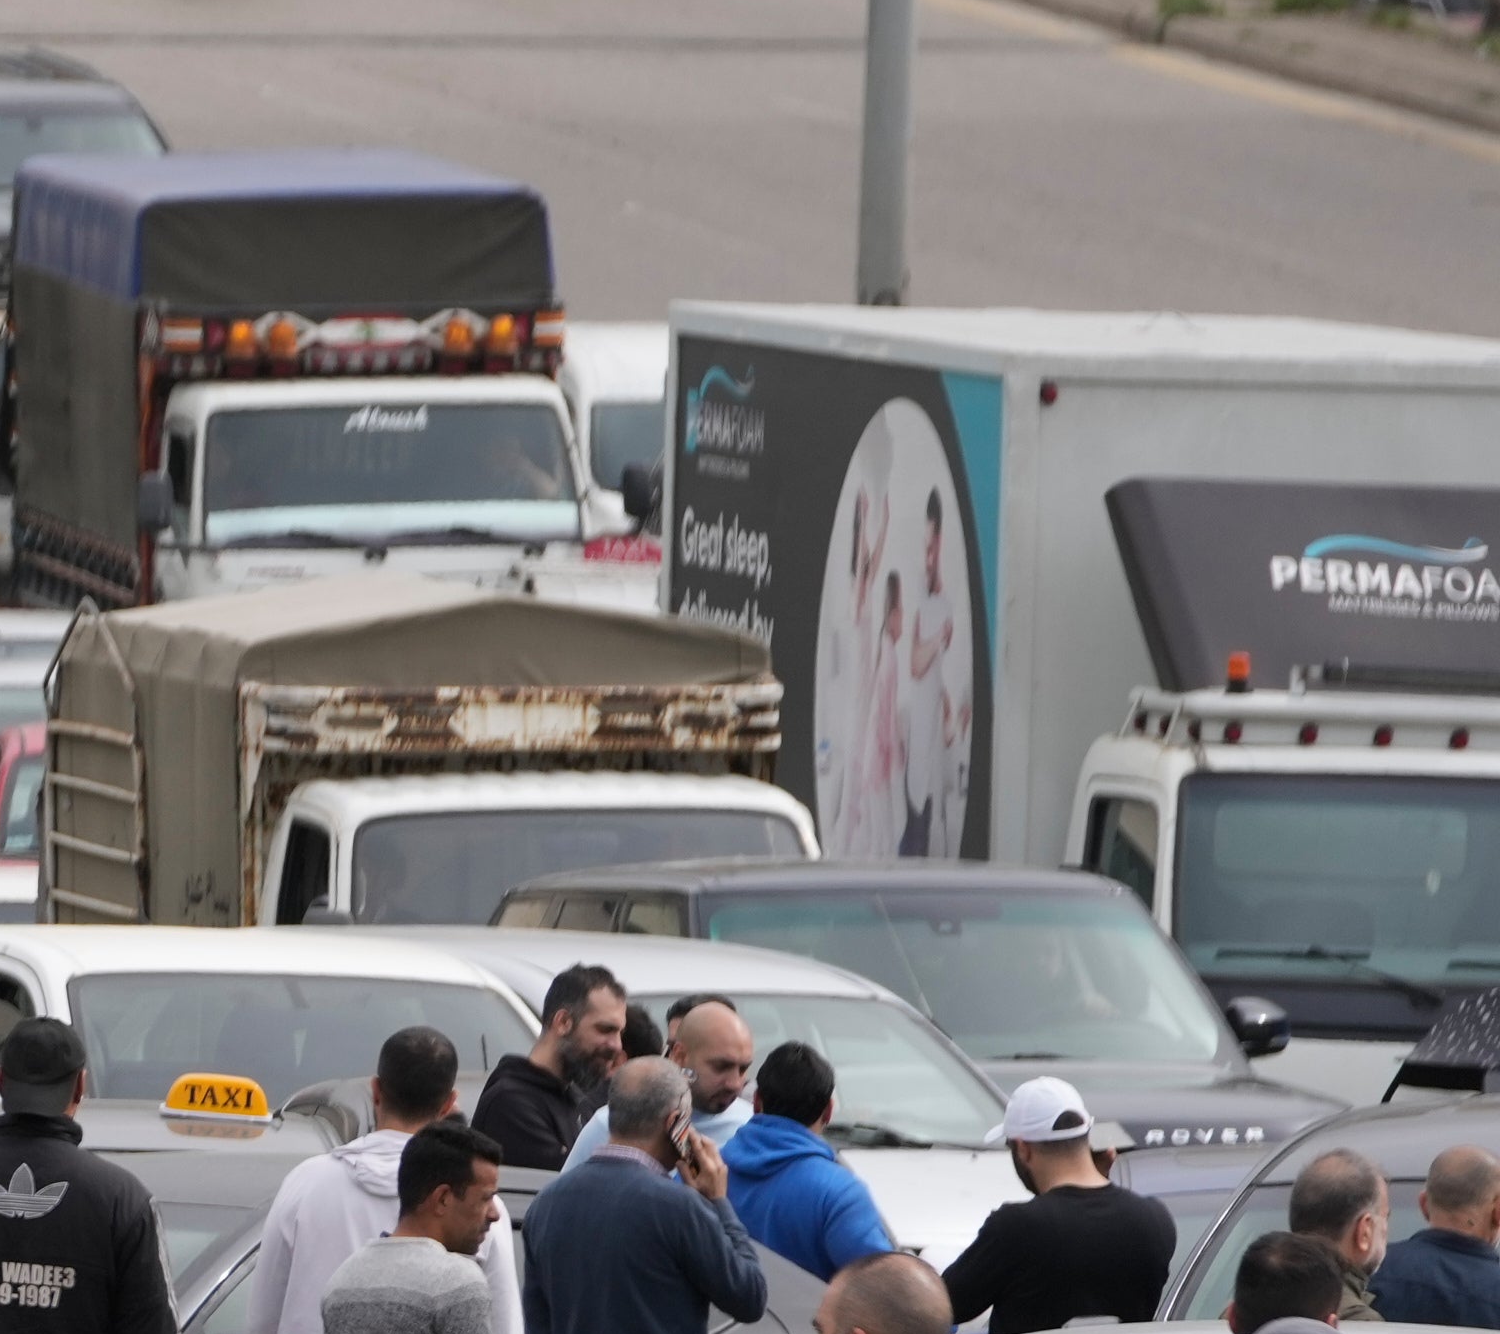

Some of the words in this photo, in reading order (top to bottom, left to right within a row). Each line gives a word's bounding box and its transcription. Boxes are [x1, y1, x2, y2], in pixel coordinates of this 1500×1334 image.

[680, 504, 724, 569] Great
[725, 513, 772, 591] sleep,
[1270, 554, 1500, 604] PERMAFOA
[184, 1083, 255, 1108] TAXI
[1145, 1126, 1265, 1146] ROVER
[1, 1261, 76, 1289] WADEE3
